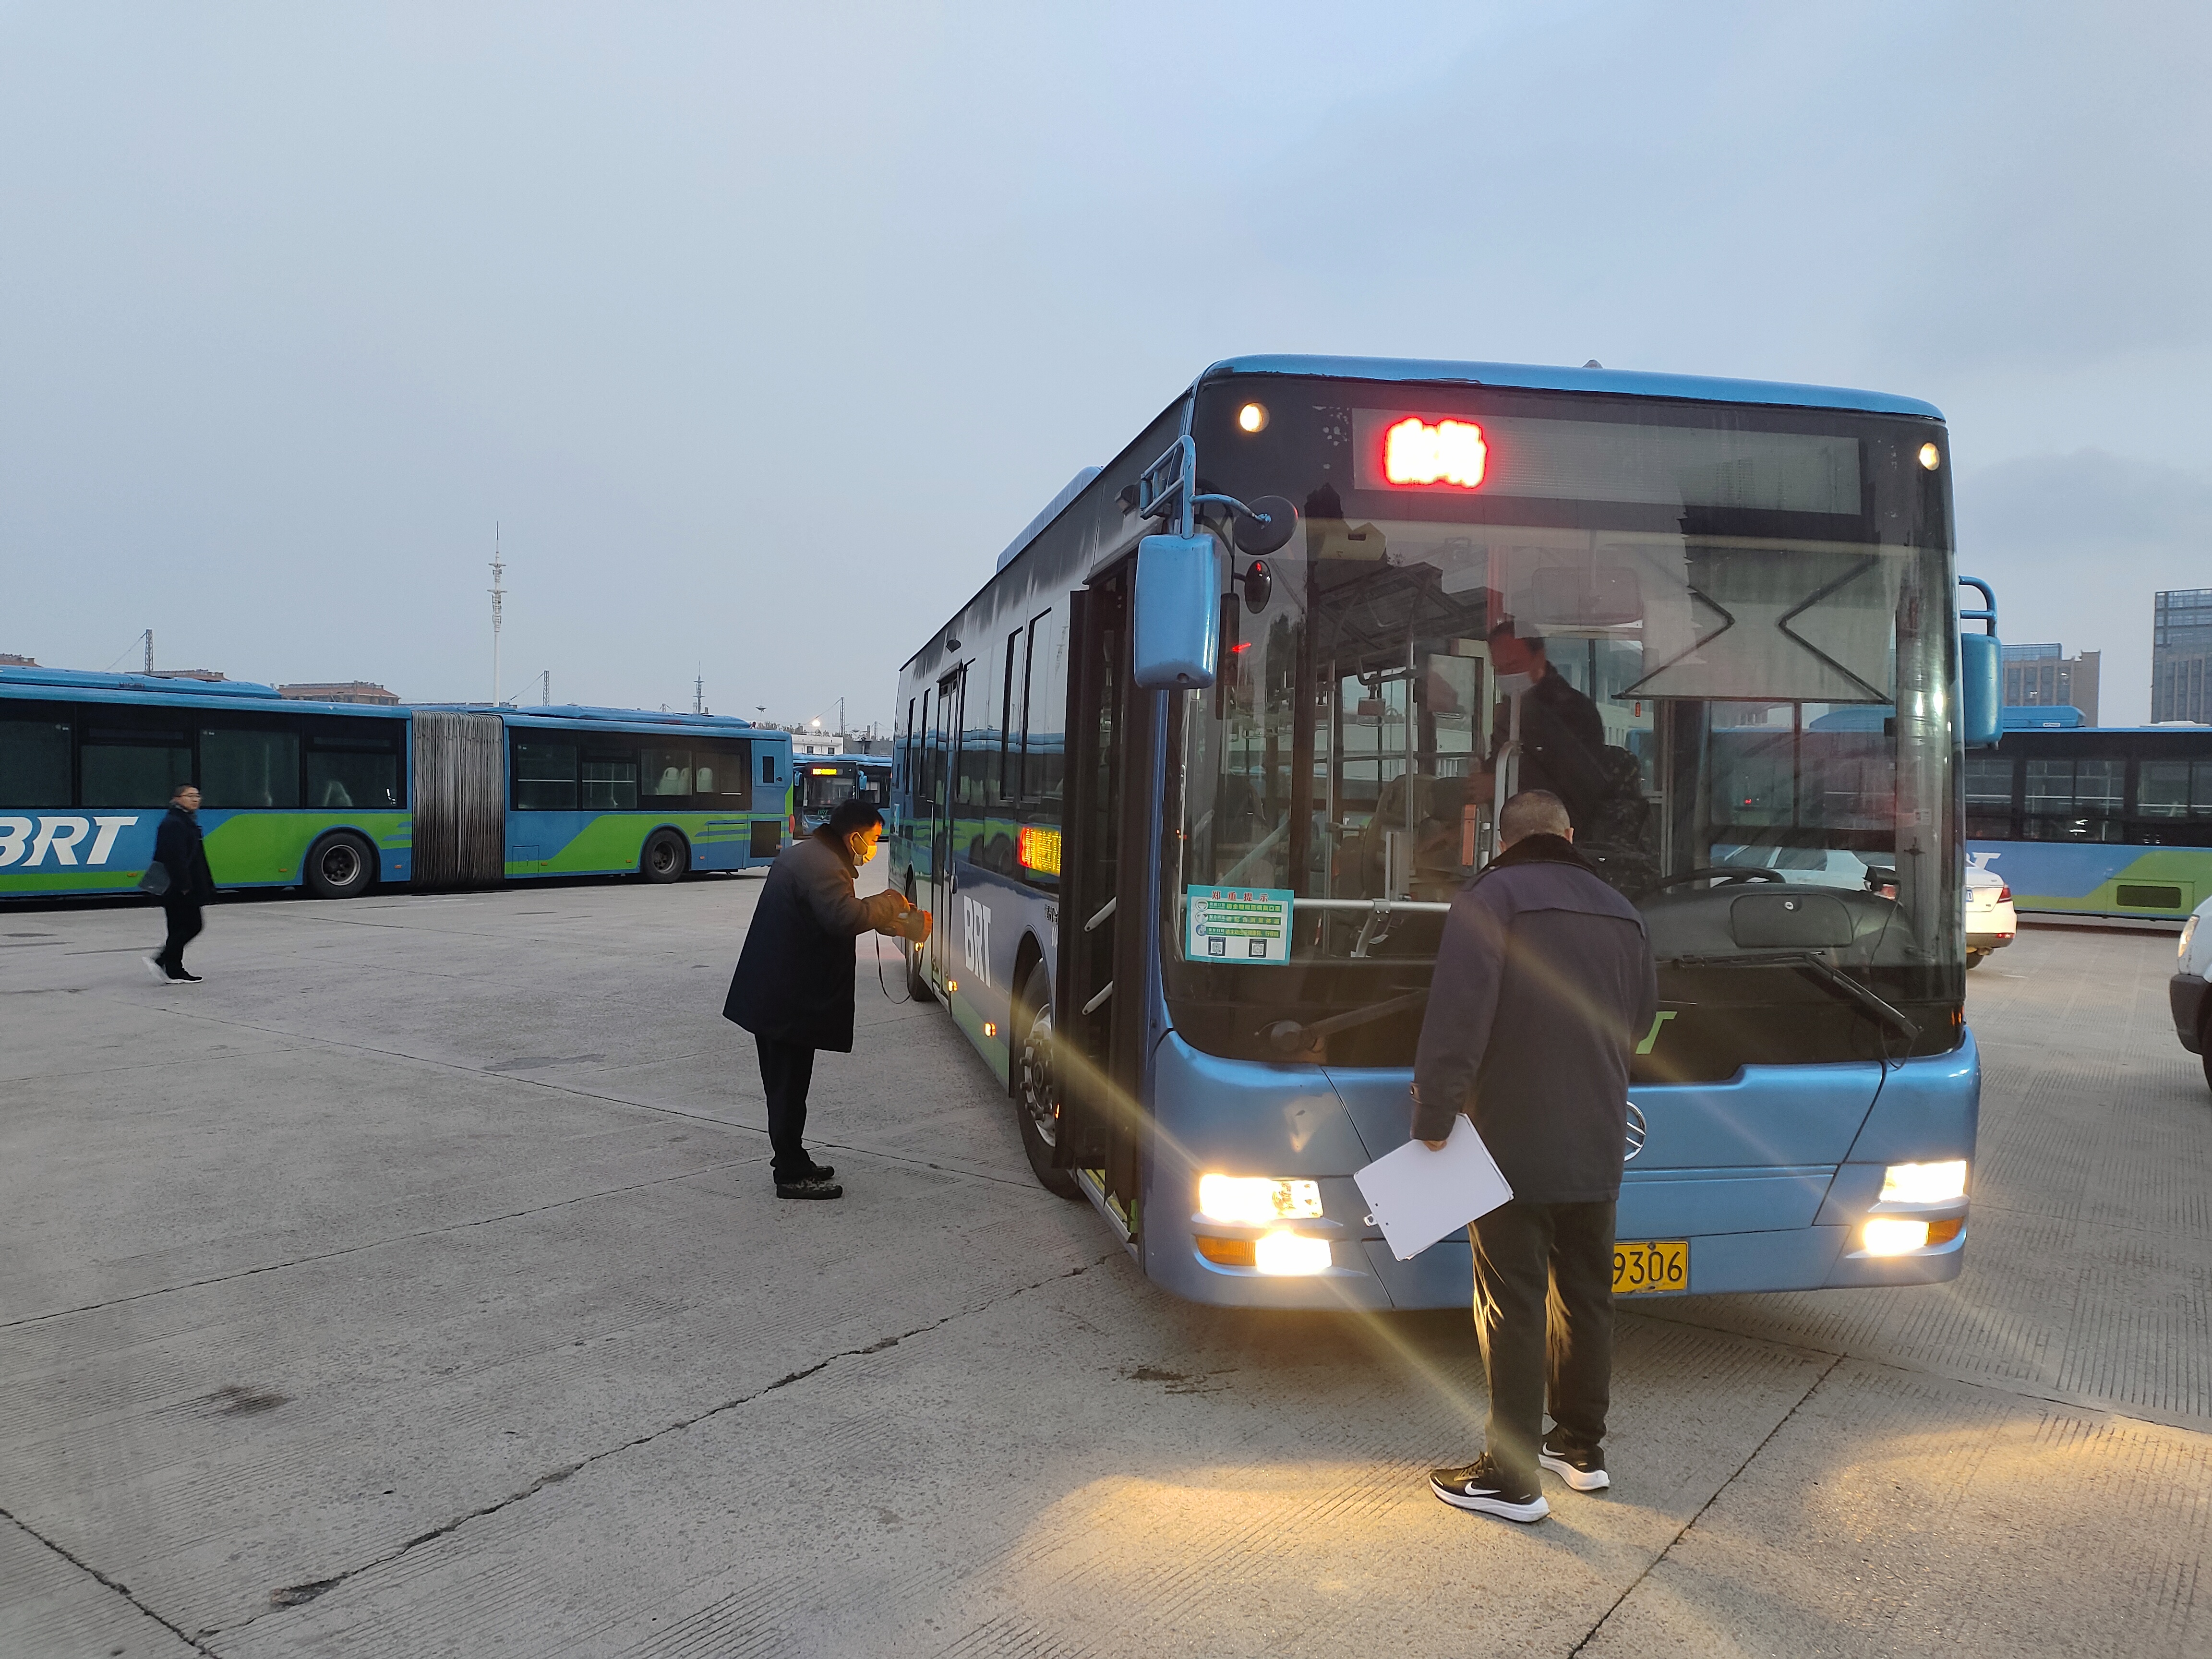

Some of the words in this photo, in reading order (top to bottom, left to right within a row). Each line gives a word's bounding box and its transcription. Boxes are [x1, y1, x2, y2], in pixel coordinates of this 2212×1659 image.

[0, 816, 139, 866] BRT
[1212, 891, 1268, 902] 郑重提示
[964, 895, 991, 988] BRT
[1613, 1250, 1683, 1285] 9306
